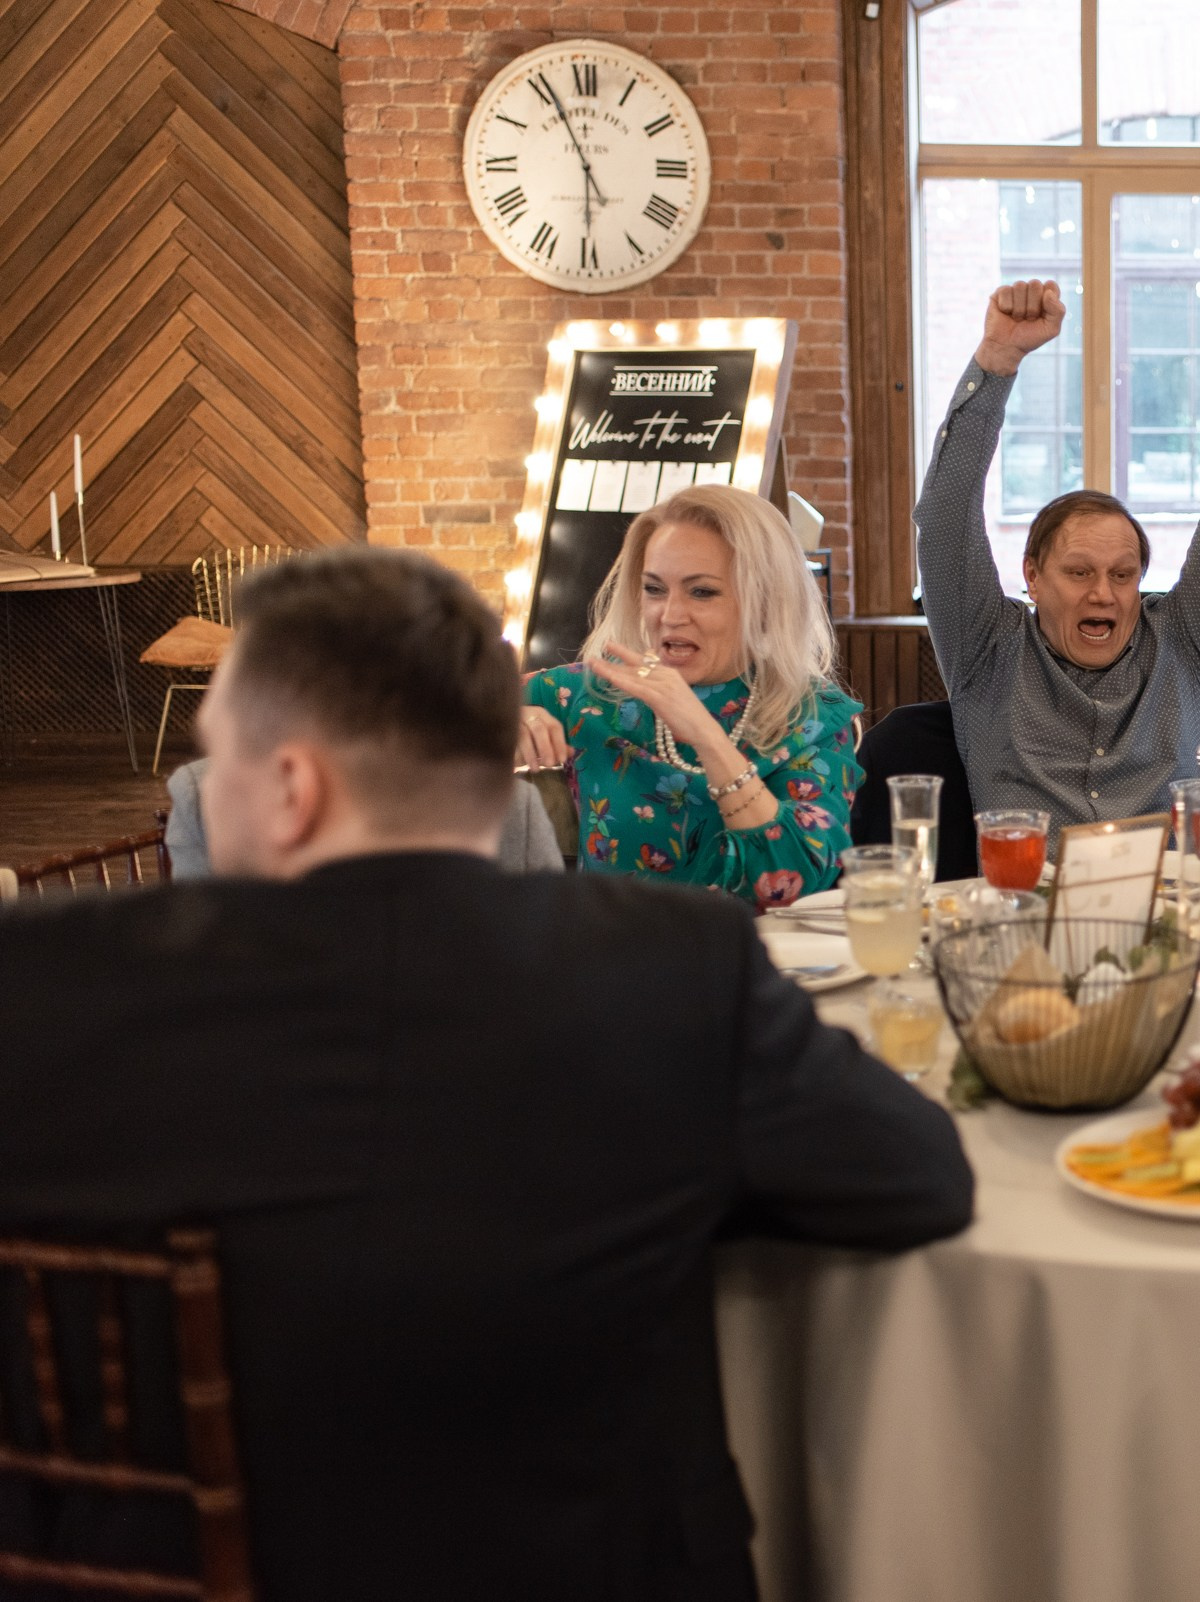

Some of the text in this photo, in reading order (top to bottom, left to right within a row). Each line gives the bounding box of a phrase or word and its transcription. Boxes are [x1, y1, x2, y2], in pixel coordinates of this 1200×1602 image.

[572, 63, 597, 97] XII
[495, 109, 528, 136] X
[643, 113, 675, 138] II
[485, 152, 518, 172] IX
[656, 158, 688, 179] III
[493, 185, 530, 228] VIII
[529, 221, 561, 259] VII
[580, 236, 599, 270] VI
[613, 369, 714, 393] ВЕСЕННИЙ
[568, 409, 742, 451] Welcome to the event
